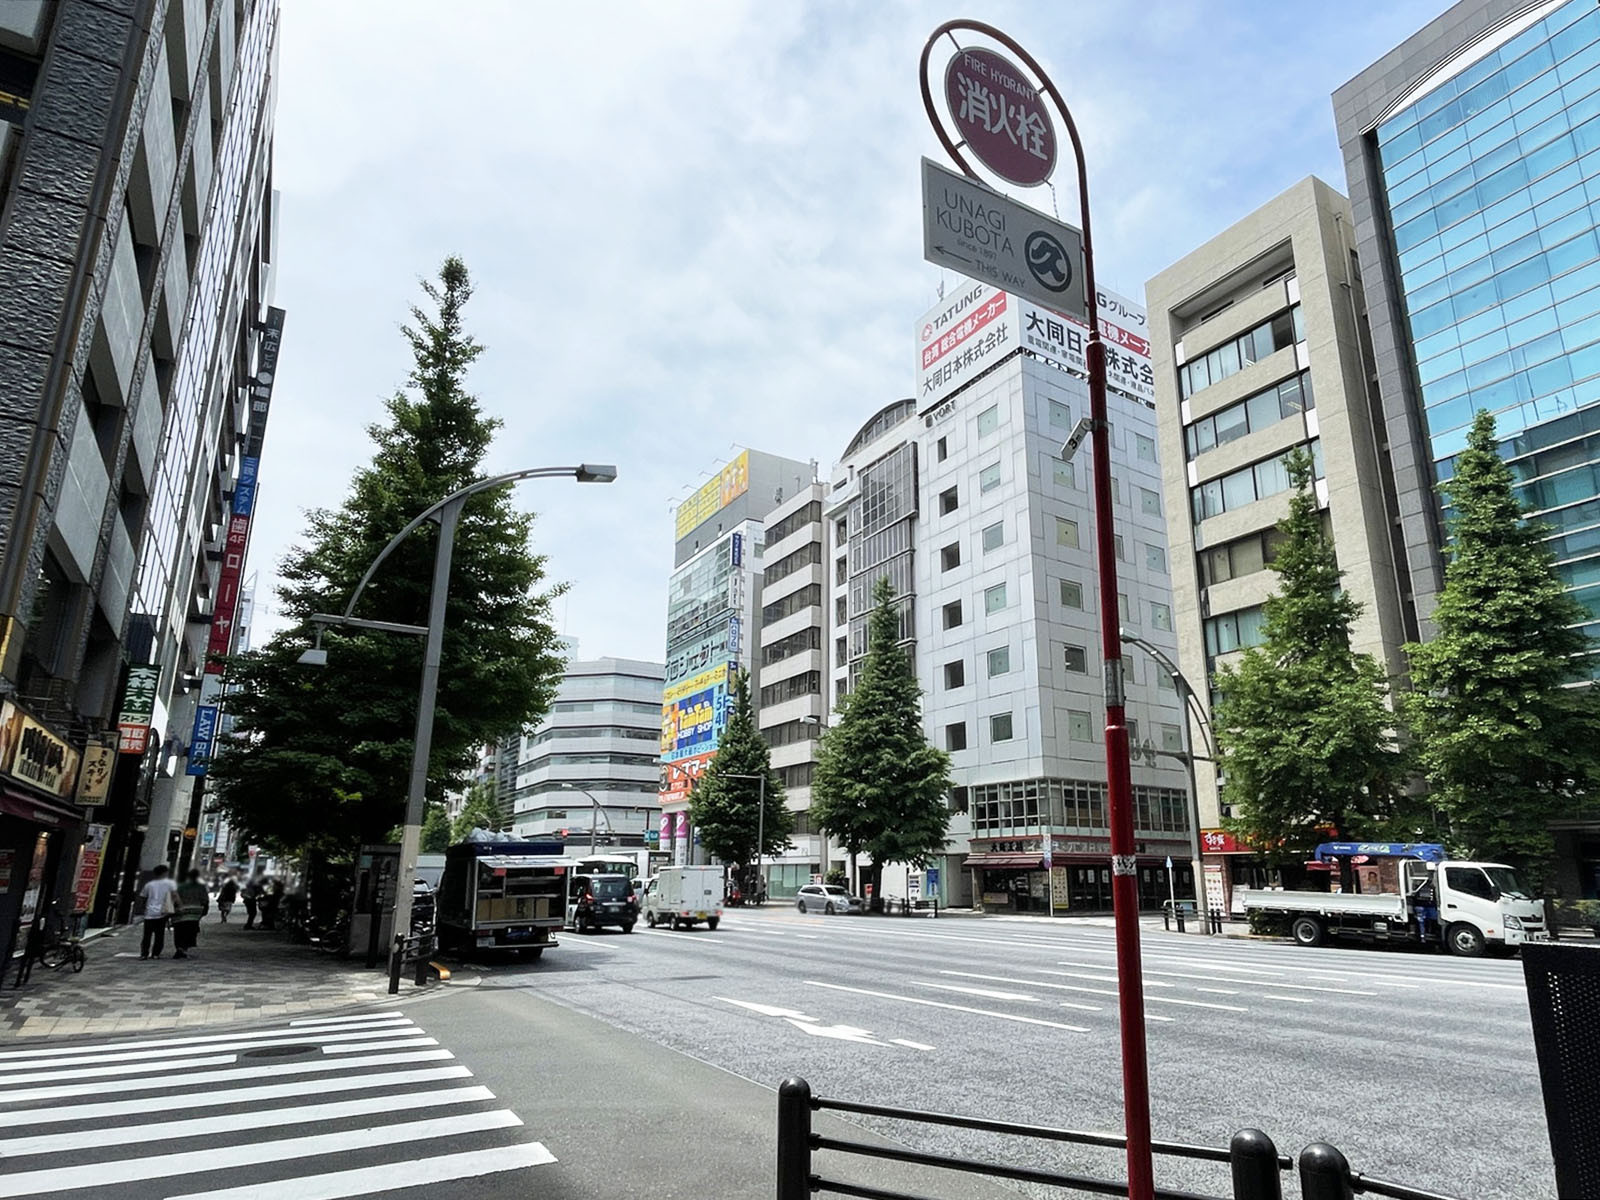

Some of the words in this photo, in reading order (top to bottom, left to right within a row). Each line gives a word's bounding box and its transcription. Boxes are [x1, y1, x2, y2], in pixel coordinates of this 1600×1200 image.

[964, 54, 988, 77] FIRE
[990, 68, 1036, 102] HYDRANT
[957, 72, 1048, 161] 消火栓
[936, 206, 1014, 257] KUBOTA
[944, 188, 1006, 232] UNAGI
[975, 259, 998, 279] THIS
[1002, 270, 1026, 288] WAY
[933, 284, 983, 330] TATUNG
[923, 322, 1009, 397] 大同日本株式会社
[1025, 311, 1155, 386] 大同日株式会
[229, 535, 246, 544] 4F
[120, 714, 149, 723] ストア
